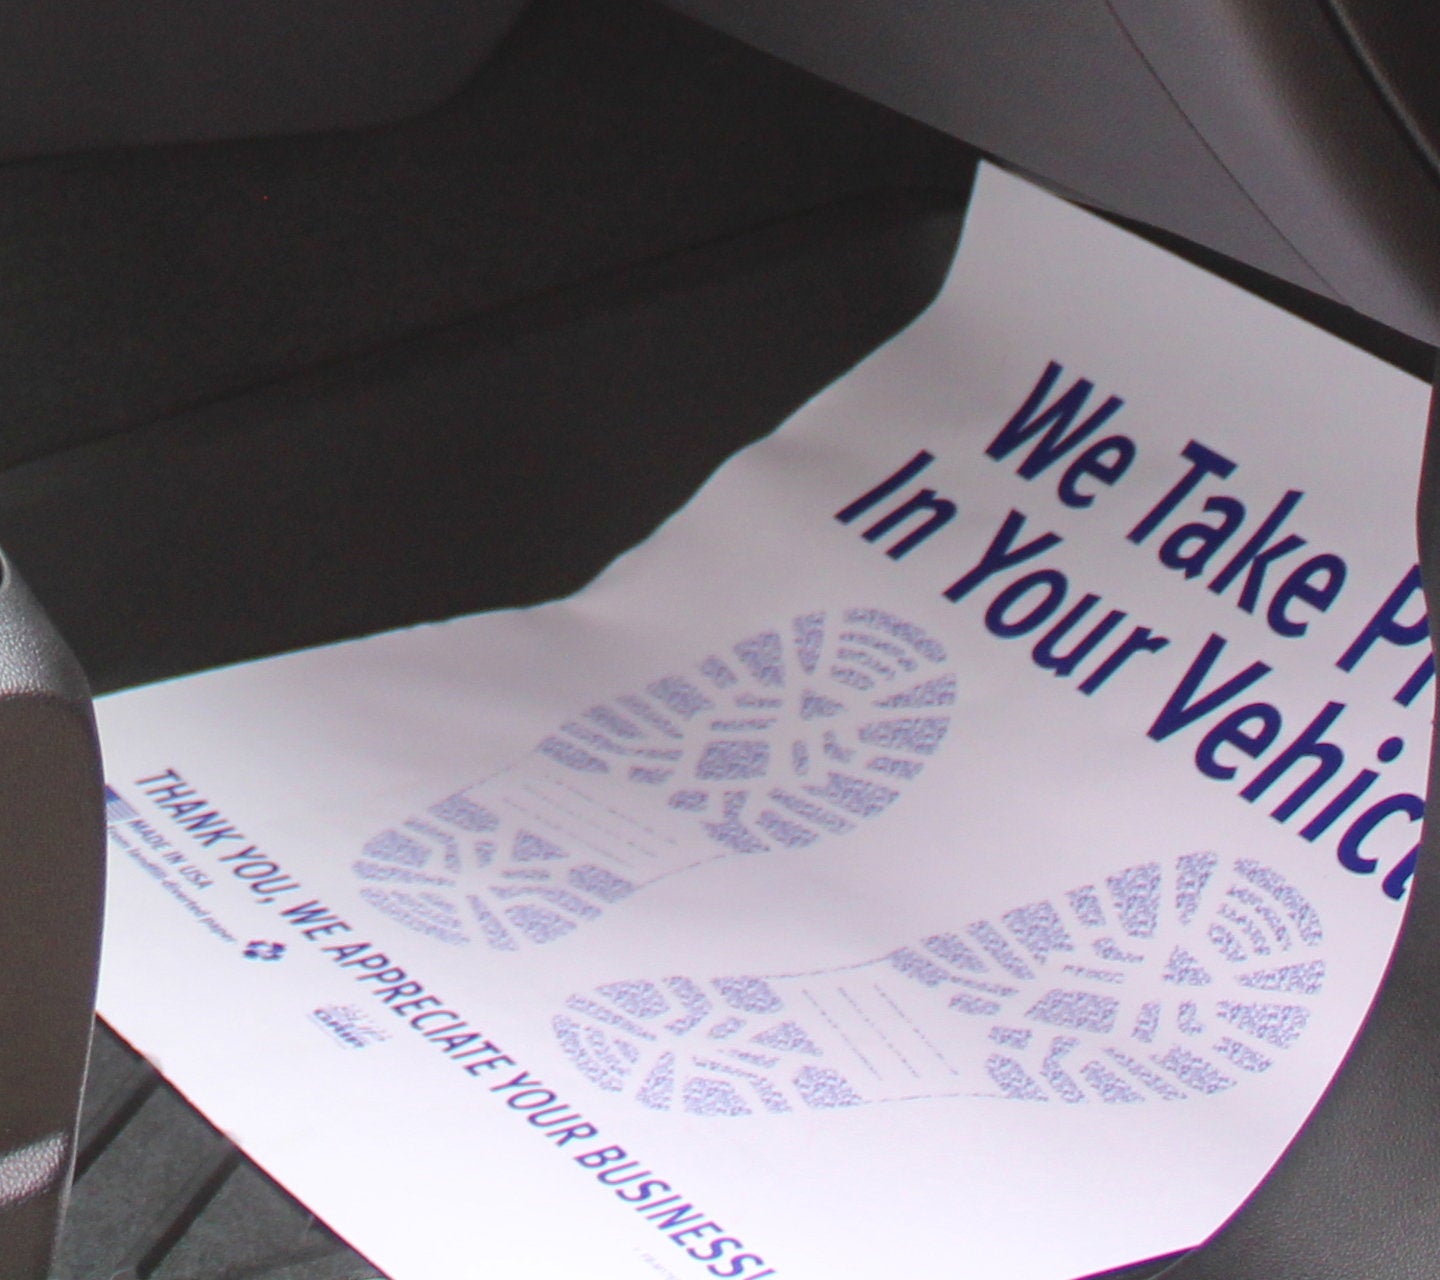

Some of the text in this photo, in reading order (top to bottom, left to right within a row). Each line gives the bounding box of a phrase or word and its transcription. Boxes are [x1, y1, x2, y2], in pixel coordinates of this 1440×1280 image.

[833, 448, 959, 562] In
[942, 508, 1170, 696] Your
[985, 359, 1137, 509] We
[1126, 439, 1348, 639] Take
[128, 819, 214, 890] MADE IN USA
[135, 768, 245, 847] THANK
[218, 845, 301, 904] YOU,
[279, 899, 353, 941] WE
[320, 941, 517, 1077] APPRECIATE
[489, 1070, 599, 1147] YOUR
